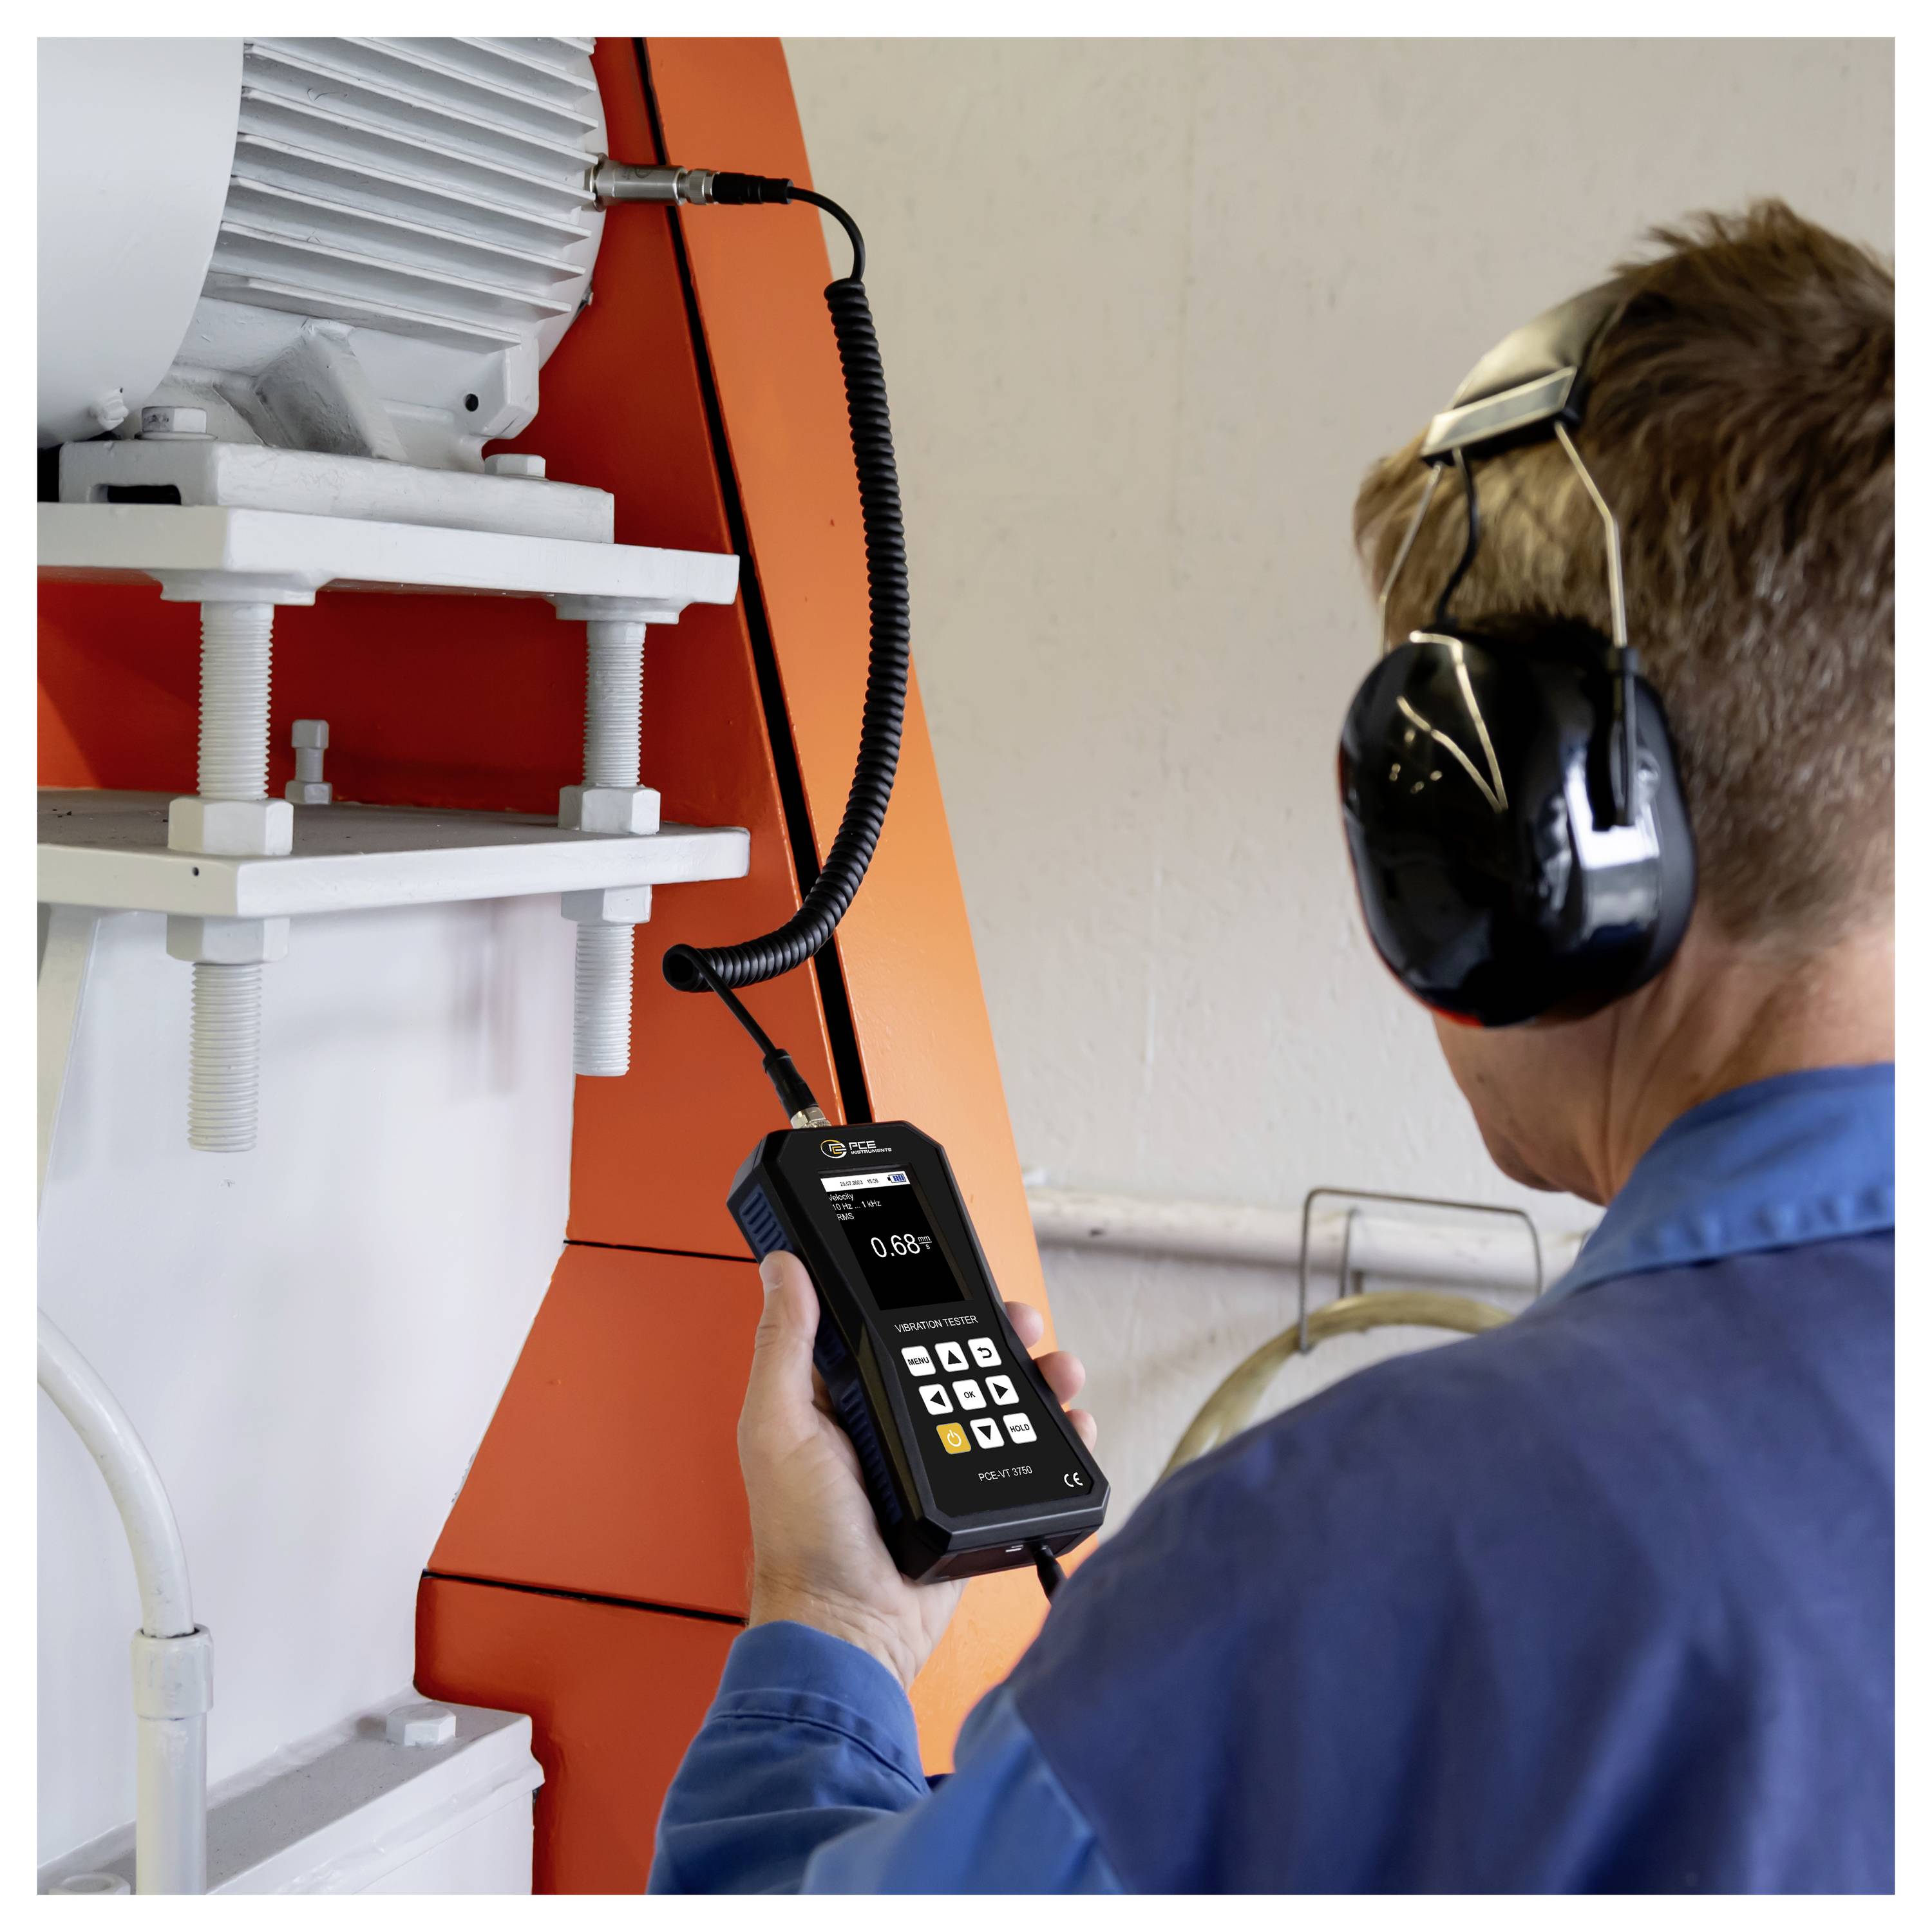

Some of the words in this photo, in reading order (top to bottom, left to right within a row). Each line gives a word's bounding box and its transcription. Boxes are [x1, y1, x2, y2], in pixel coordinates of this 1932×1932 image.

[848, 1141, 876, 1150] PCE
[829, 1193, 854, 1202] Velocity
[837, 1212, 855, 1221] RMS
[871, 1233, 920, 1258] 0.68
[894, 1320, 943, 1332] VIBRATION
[942, 1315, 979, 1327] TESTER
[907, 1356, 930, 1365] MENU
[1010, 1424, 1030, 1433] HOLD
[978, 1468, 1010, 1481] PCE-VT
[1012, 1465, 1033, 1477] 3750
[1064, 1472, 1083, 1488] CE
